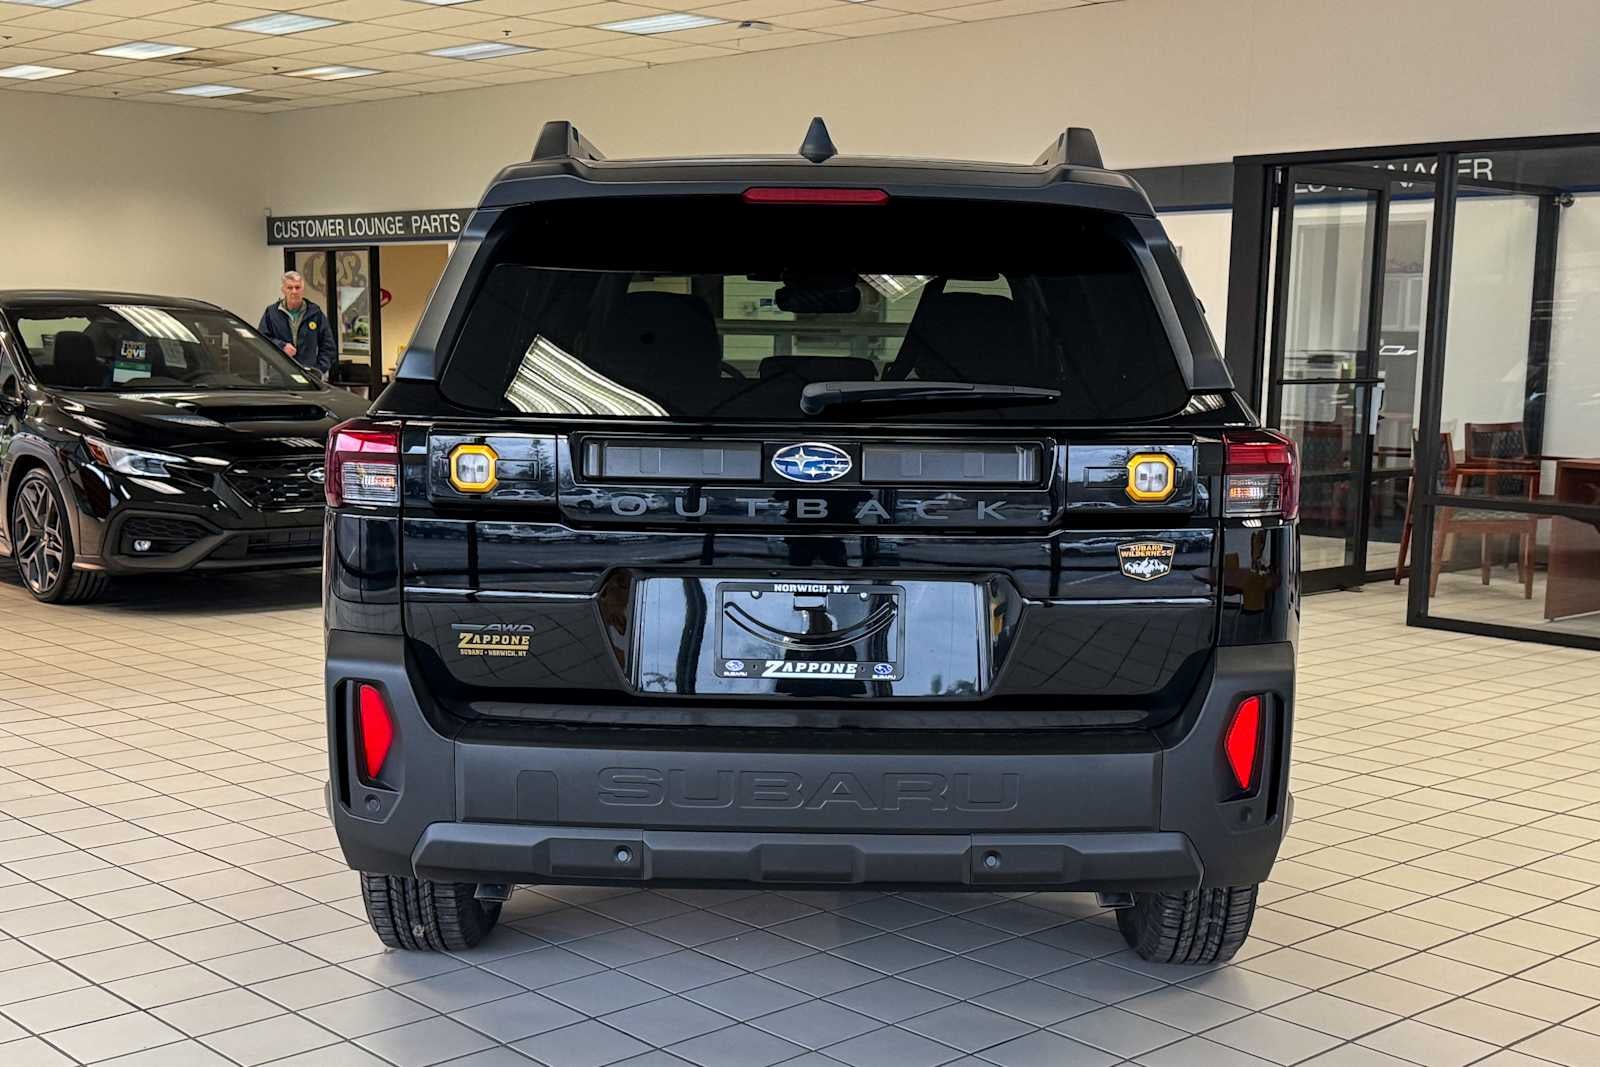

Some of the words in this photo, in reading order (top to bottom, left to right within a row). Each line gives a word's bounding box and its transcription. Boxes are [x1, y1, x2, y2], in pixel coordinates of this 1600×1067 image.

[273, 218, 345, 239] CUSTOMER
[348, 216, 405, 236] LOUNGE
[411, 213, 461, 234] PARTS
[610, 496, 1007, 520] OUTBACK
[833, 585, 850, 593] NY
[481, 623, 535, 632] AWD
[458, 632, 530, 650] ZAPPONE
[761, 660, 858, 679] ZAPPONE
[597, 766, 1020, 812] SUBARU
